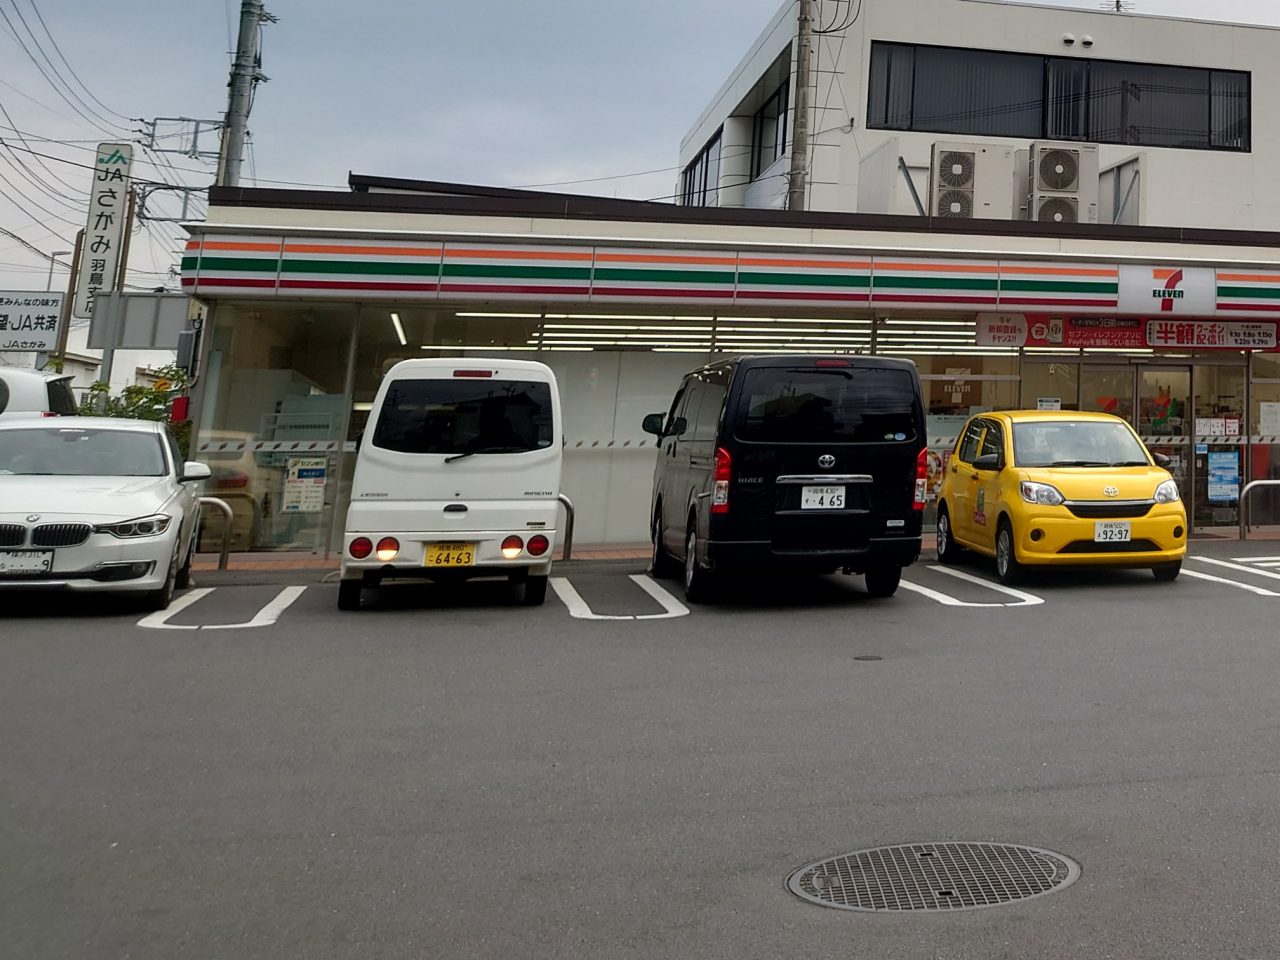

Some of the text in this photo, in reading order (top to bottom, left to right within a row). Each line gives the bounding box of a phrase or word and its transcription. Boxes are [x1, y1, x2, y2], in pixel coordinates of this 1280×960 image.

[1156, 322, 1195, 345] 半額
[1196, 323, 1225, 334] クーポン
[3, 340, 47, 348] JAさがみ
